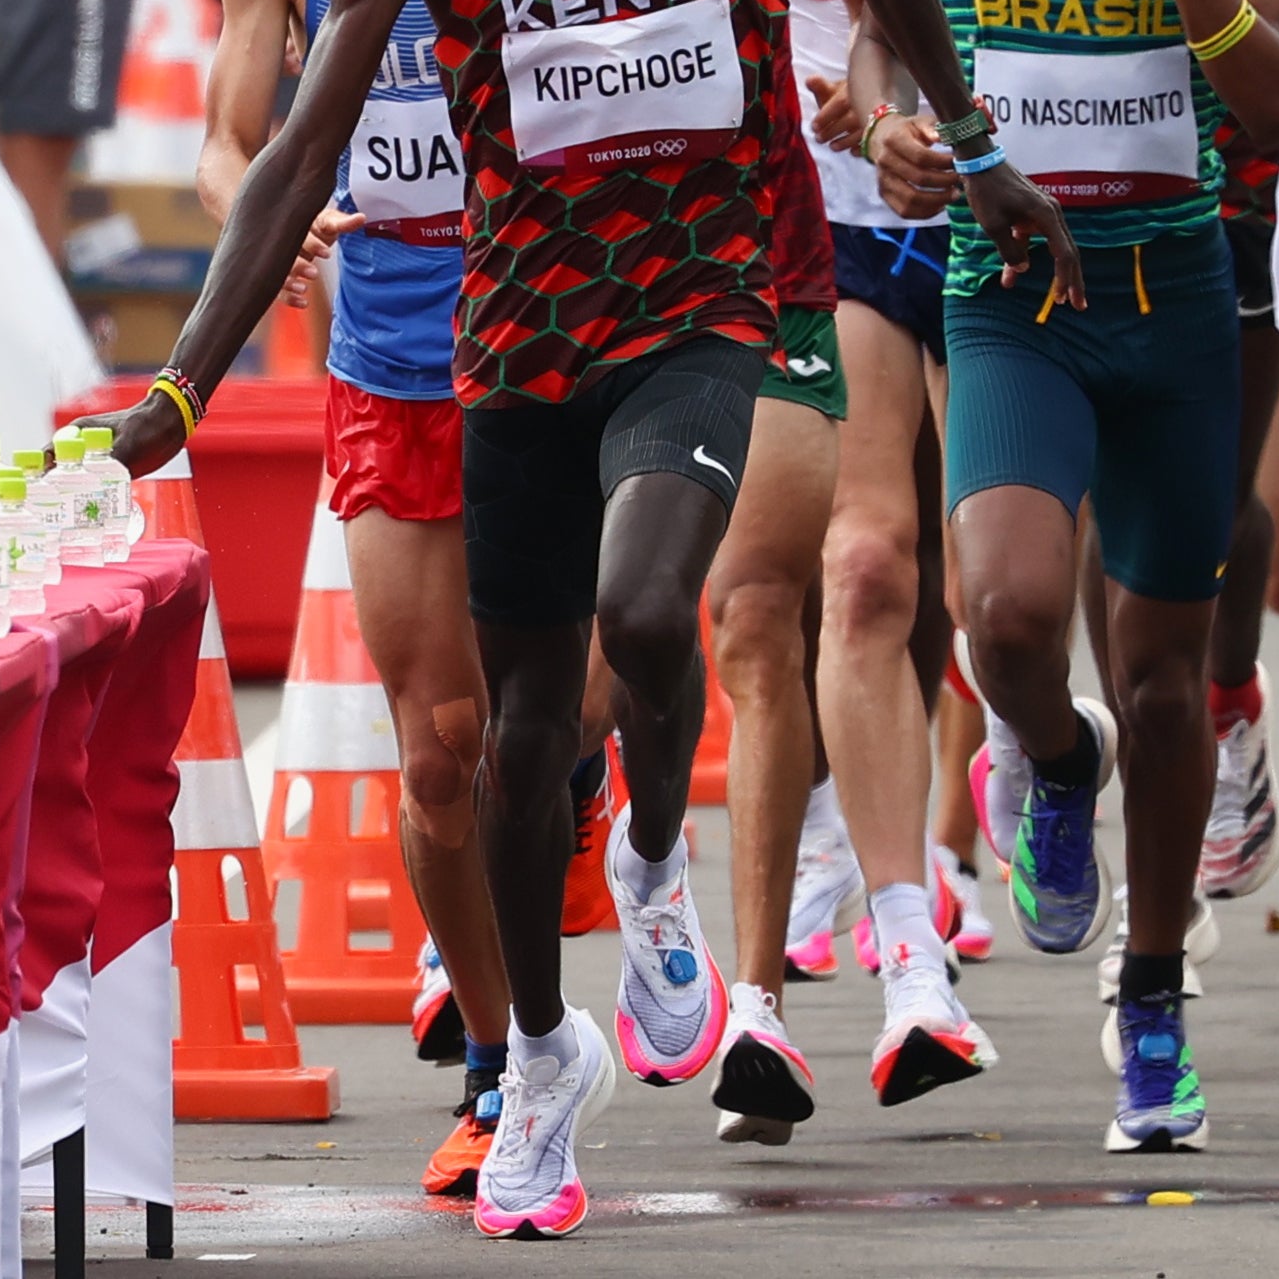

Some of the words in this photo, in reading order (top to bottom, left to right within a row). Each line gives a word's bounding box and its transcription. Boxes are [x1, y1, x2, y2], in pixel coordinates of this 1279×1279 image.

[534, 42, 717, 102] KIPCHOGE
[1022, 90, 1185, 126] NASCIMENTO
[587, 149, 623, 163] TOKYO
[625, 145, 651, 159] 2020
[421, 227, 452, 237] TOKYO
